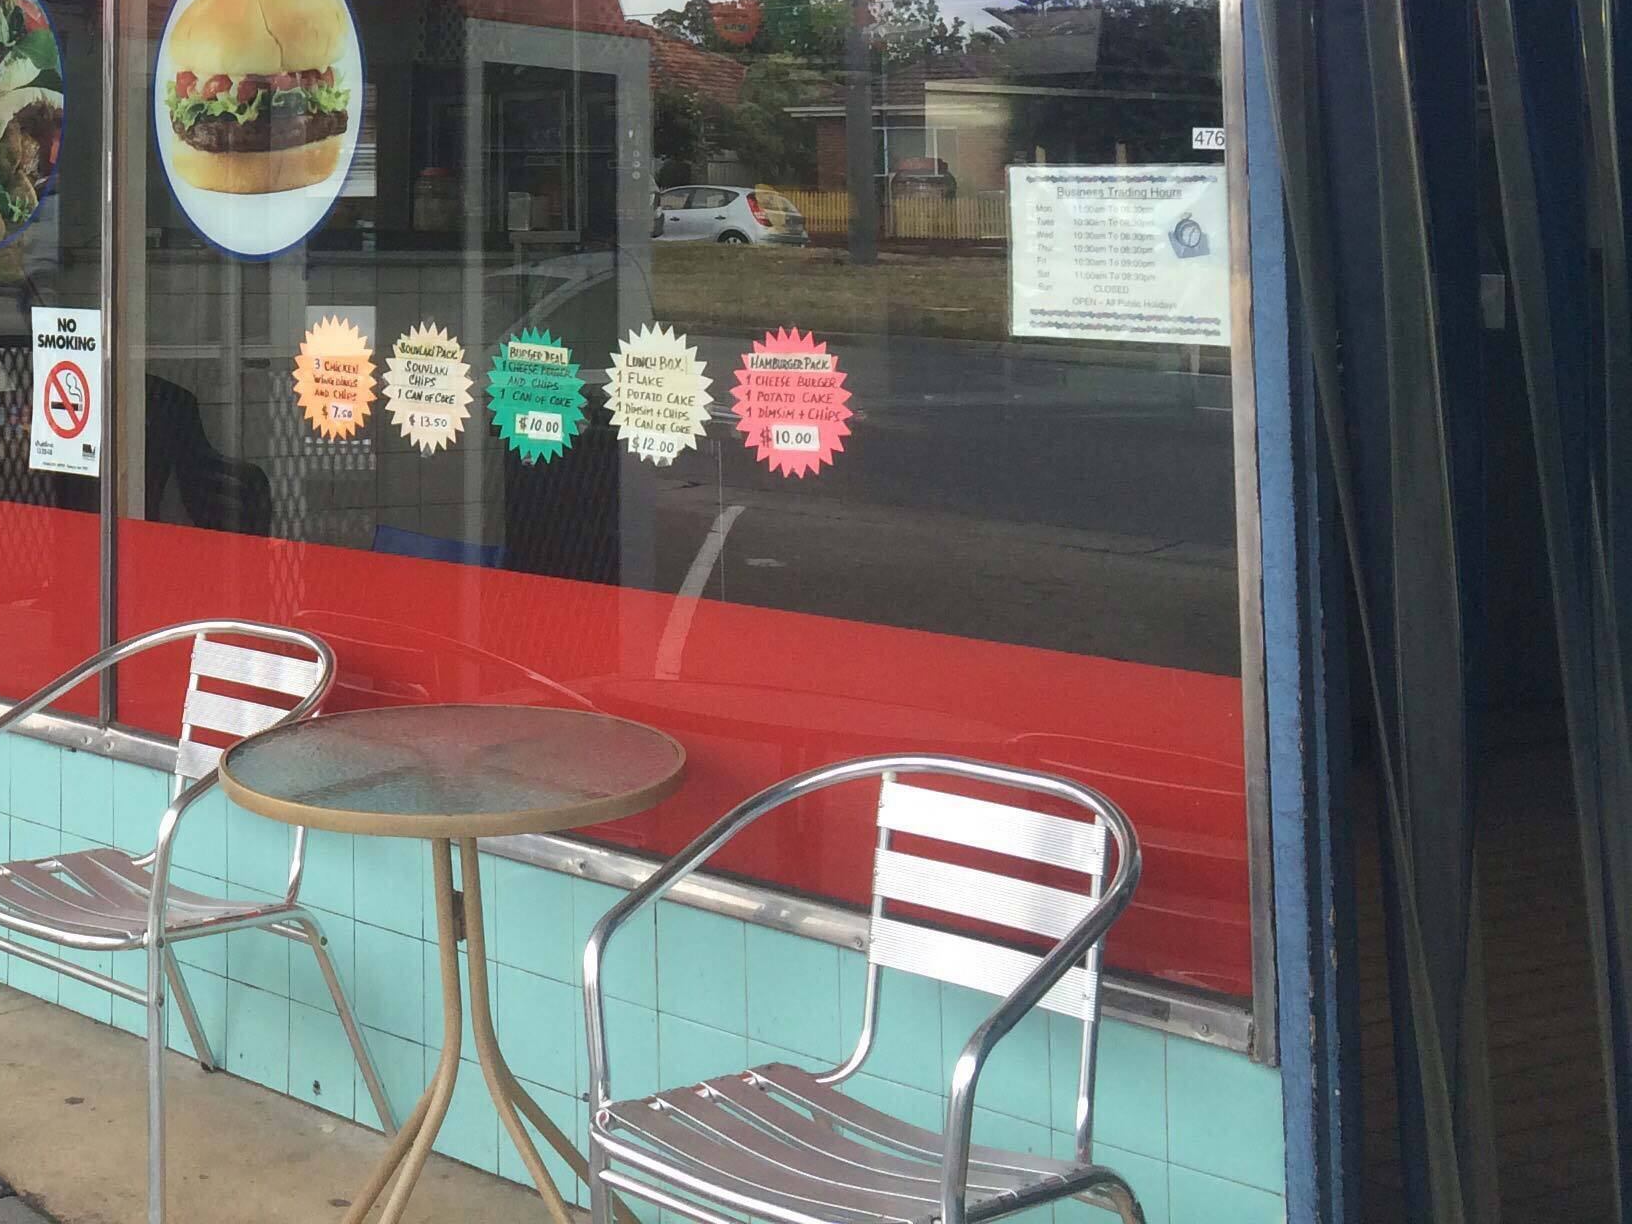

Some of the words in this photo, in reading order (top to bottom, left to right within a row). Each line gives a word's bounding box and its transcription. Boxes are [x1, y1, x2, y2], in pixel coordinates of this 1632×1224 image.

[1194, 130, 1225, 147] 476
[1057, 187, 1104, 198] Business
[1107, 187, 1147, 200] Trading
[1150, 188, 1183, 198] Hours
[1093, 285, 1129, 294] CLOSED
[1072, 298, 1097, 307] OPEN
[57, 317, 77, 333] NO
[37, 334, 97, 352] SMOKING
[399, 342, 435, 357] SOUVLAKI
[435, 346, 458, 360] PACK
[314, 358, 321, 370] 3
[325, 361, 359, 374] CHICKEN
[404, 360, 449, 375] SOUVLAKI
[508, 361, 539, 373] CHEESE
[626, 354, 657, 369] LUNCH
[750, 355, 803, 370] HAMBURGER
[804, 356, 830, 370] PACK
[408, 374, 436, 387] CHIPS
[507, 376, 526, 387] AND
[531, 378, 560, 391] CHIPS
[616, 370, 622, 383] 1
[627, 372, 664, 387] FLAKE
[755, 375, 791, 388] CHEESE
[314, 388, 330, 399] AND
[333, 388, 357, 401] CHIPS
[405, 389, 423, 401] CAN
[434, 392, 455, 404] COKE
[512, 391, 532, 403] CAN
[549, 396, 575, 408] COKE
[627, 388, 662, 402] POTATO
[666, 392, 696, 407] CAKE
[756, 391, 796, 403] POTATO
[802, 392, 833, 404] CAKE
[663, 407, 690, 421] CHIPS
[807, 406, 842, 422] CHIPS
[634, 417, 654, 430] CAN
[670, 422, 692, 434] COKE
